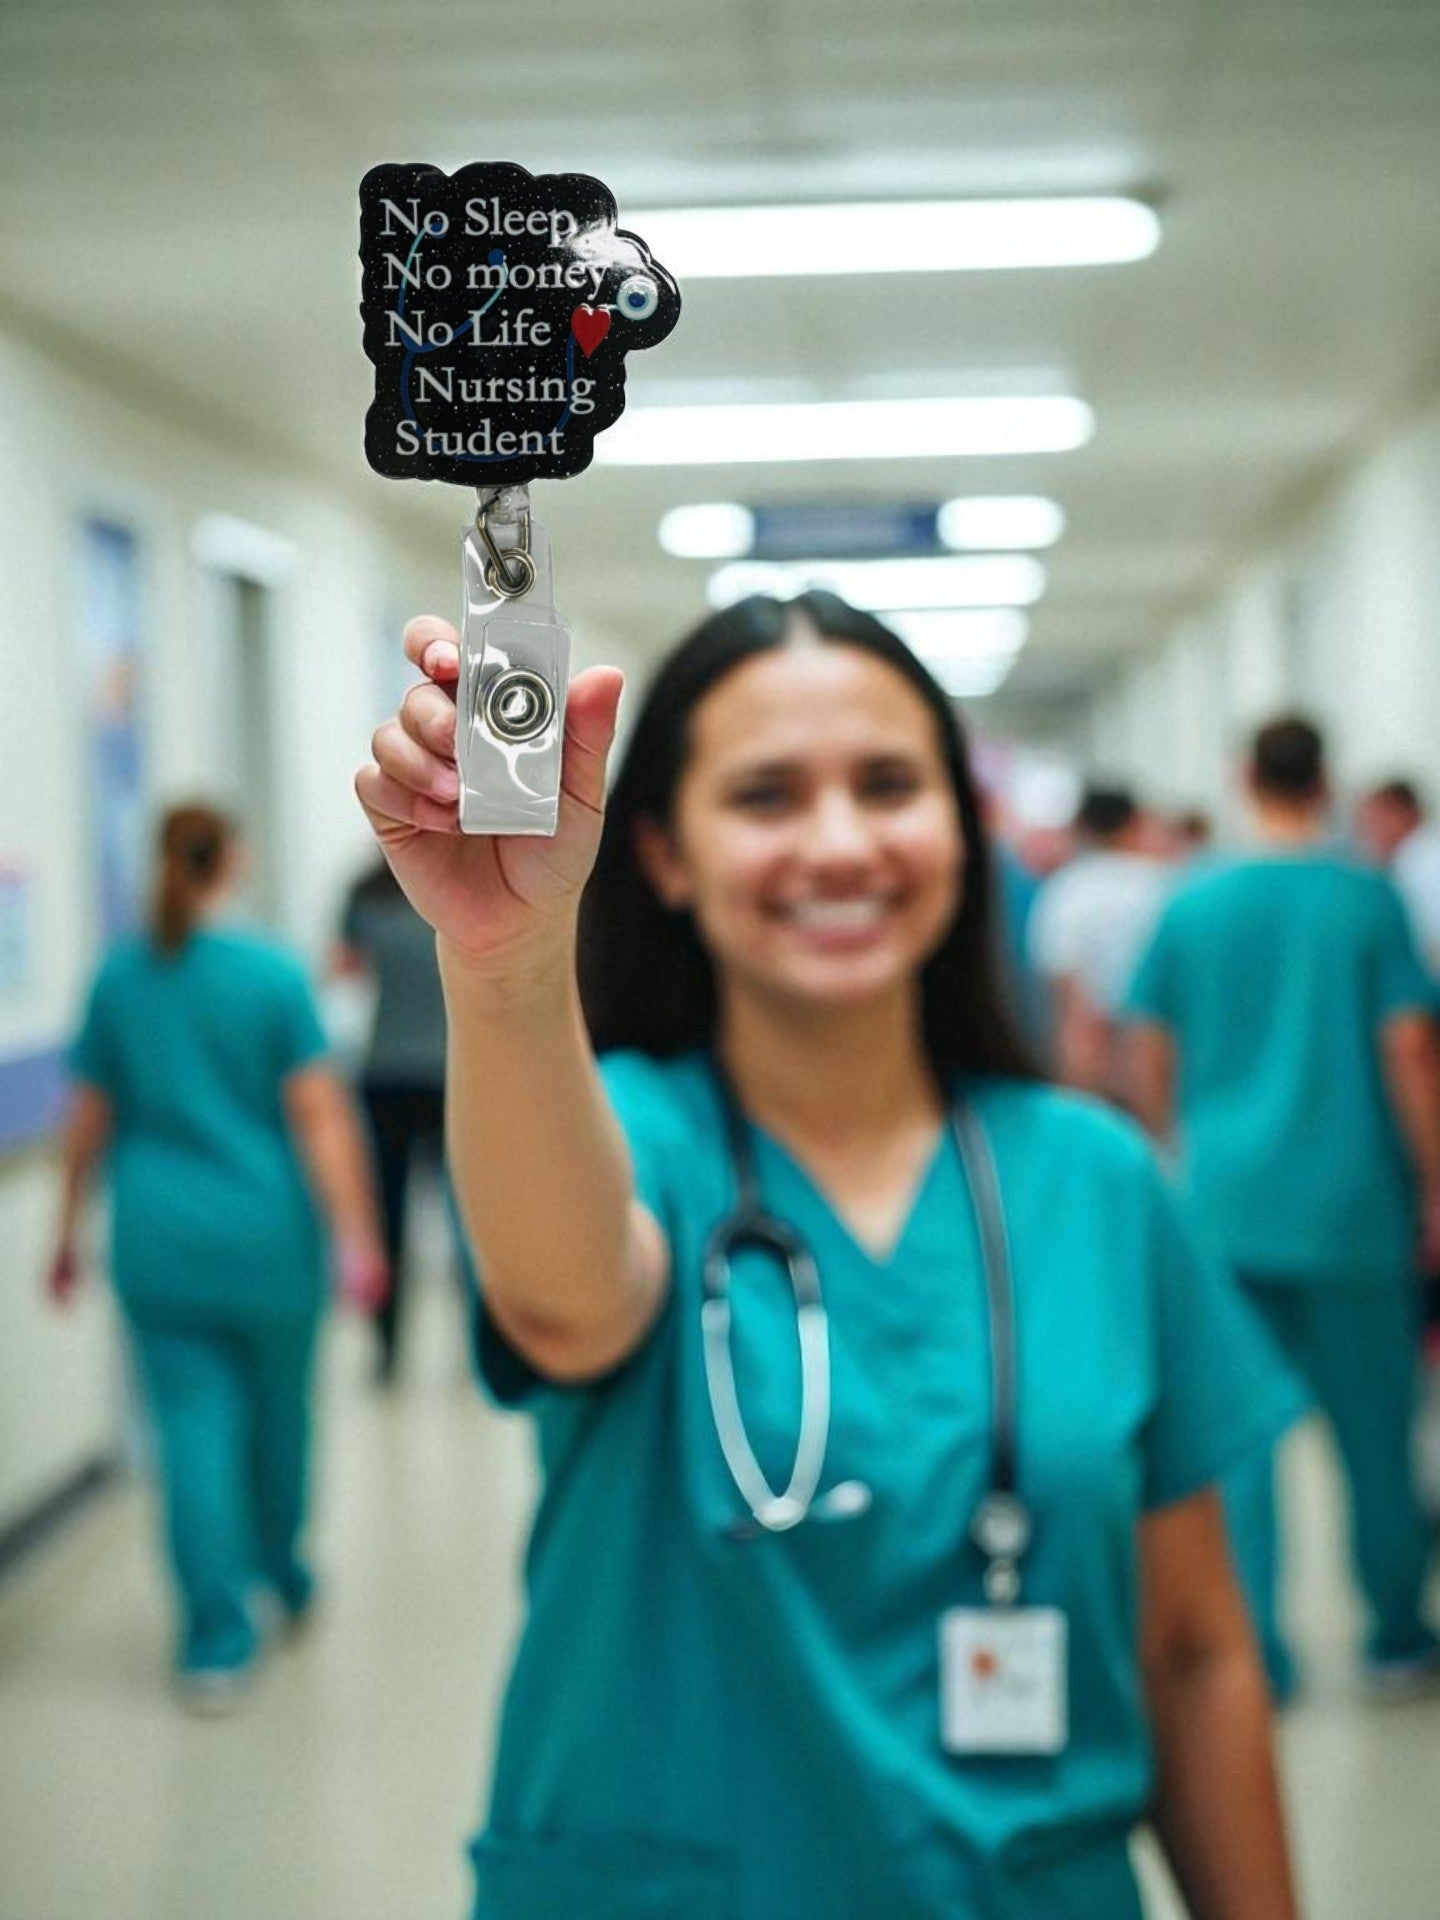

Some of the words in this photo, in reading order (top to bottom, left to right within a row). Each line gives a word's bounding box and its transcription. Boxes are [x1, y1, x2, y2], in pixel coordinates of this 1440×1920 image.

[379, 198, 449, 236] No
[464, 197, 574, 248] Sleep
[382, 252, 451, 289] No
[466, 262, 607, 300] money
[385, 310, 453, 347] No
[467, 308, 551, 346] Life
[415, 365, 596, 414] Nursing
[395, 418, 565, 456] Student
